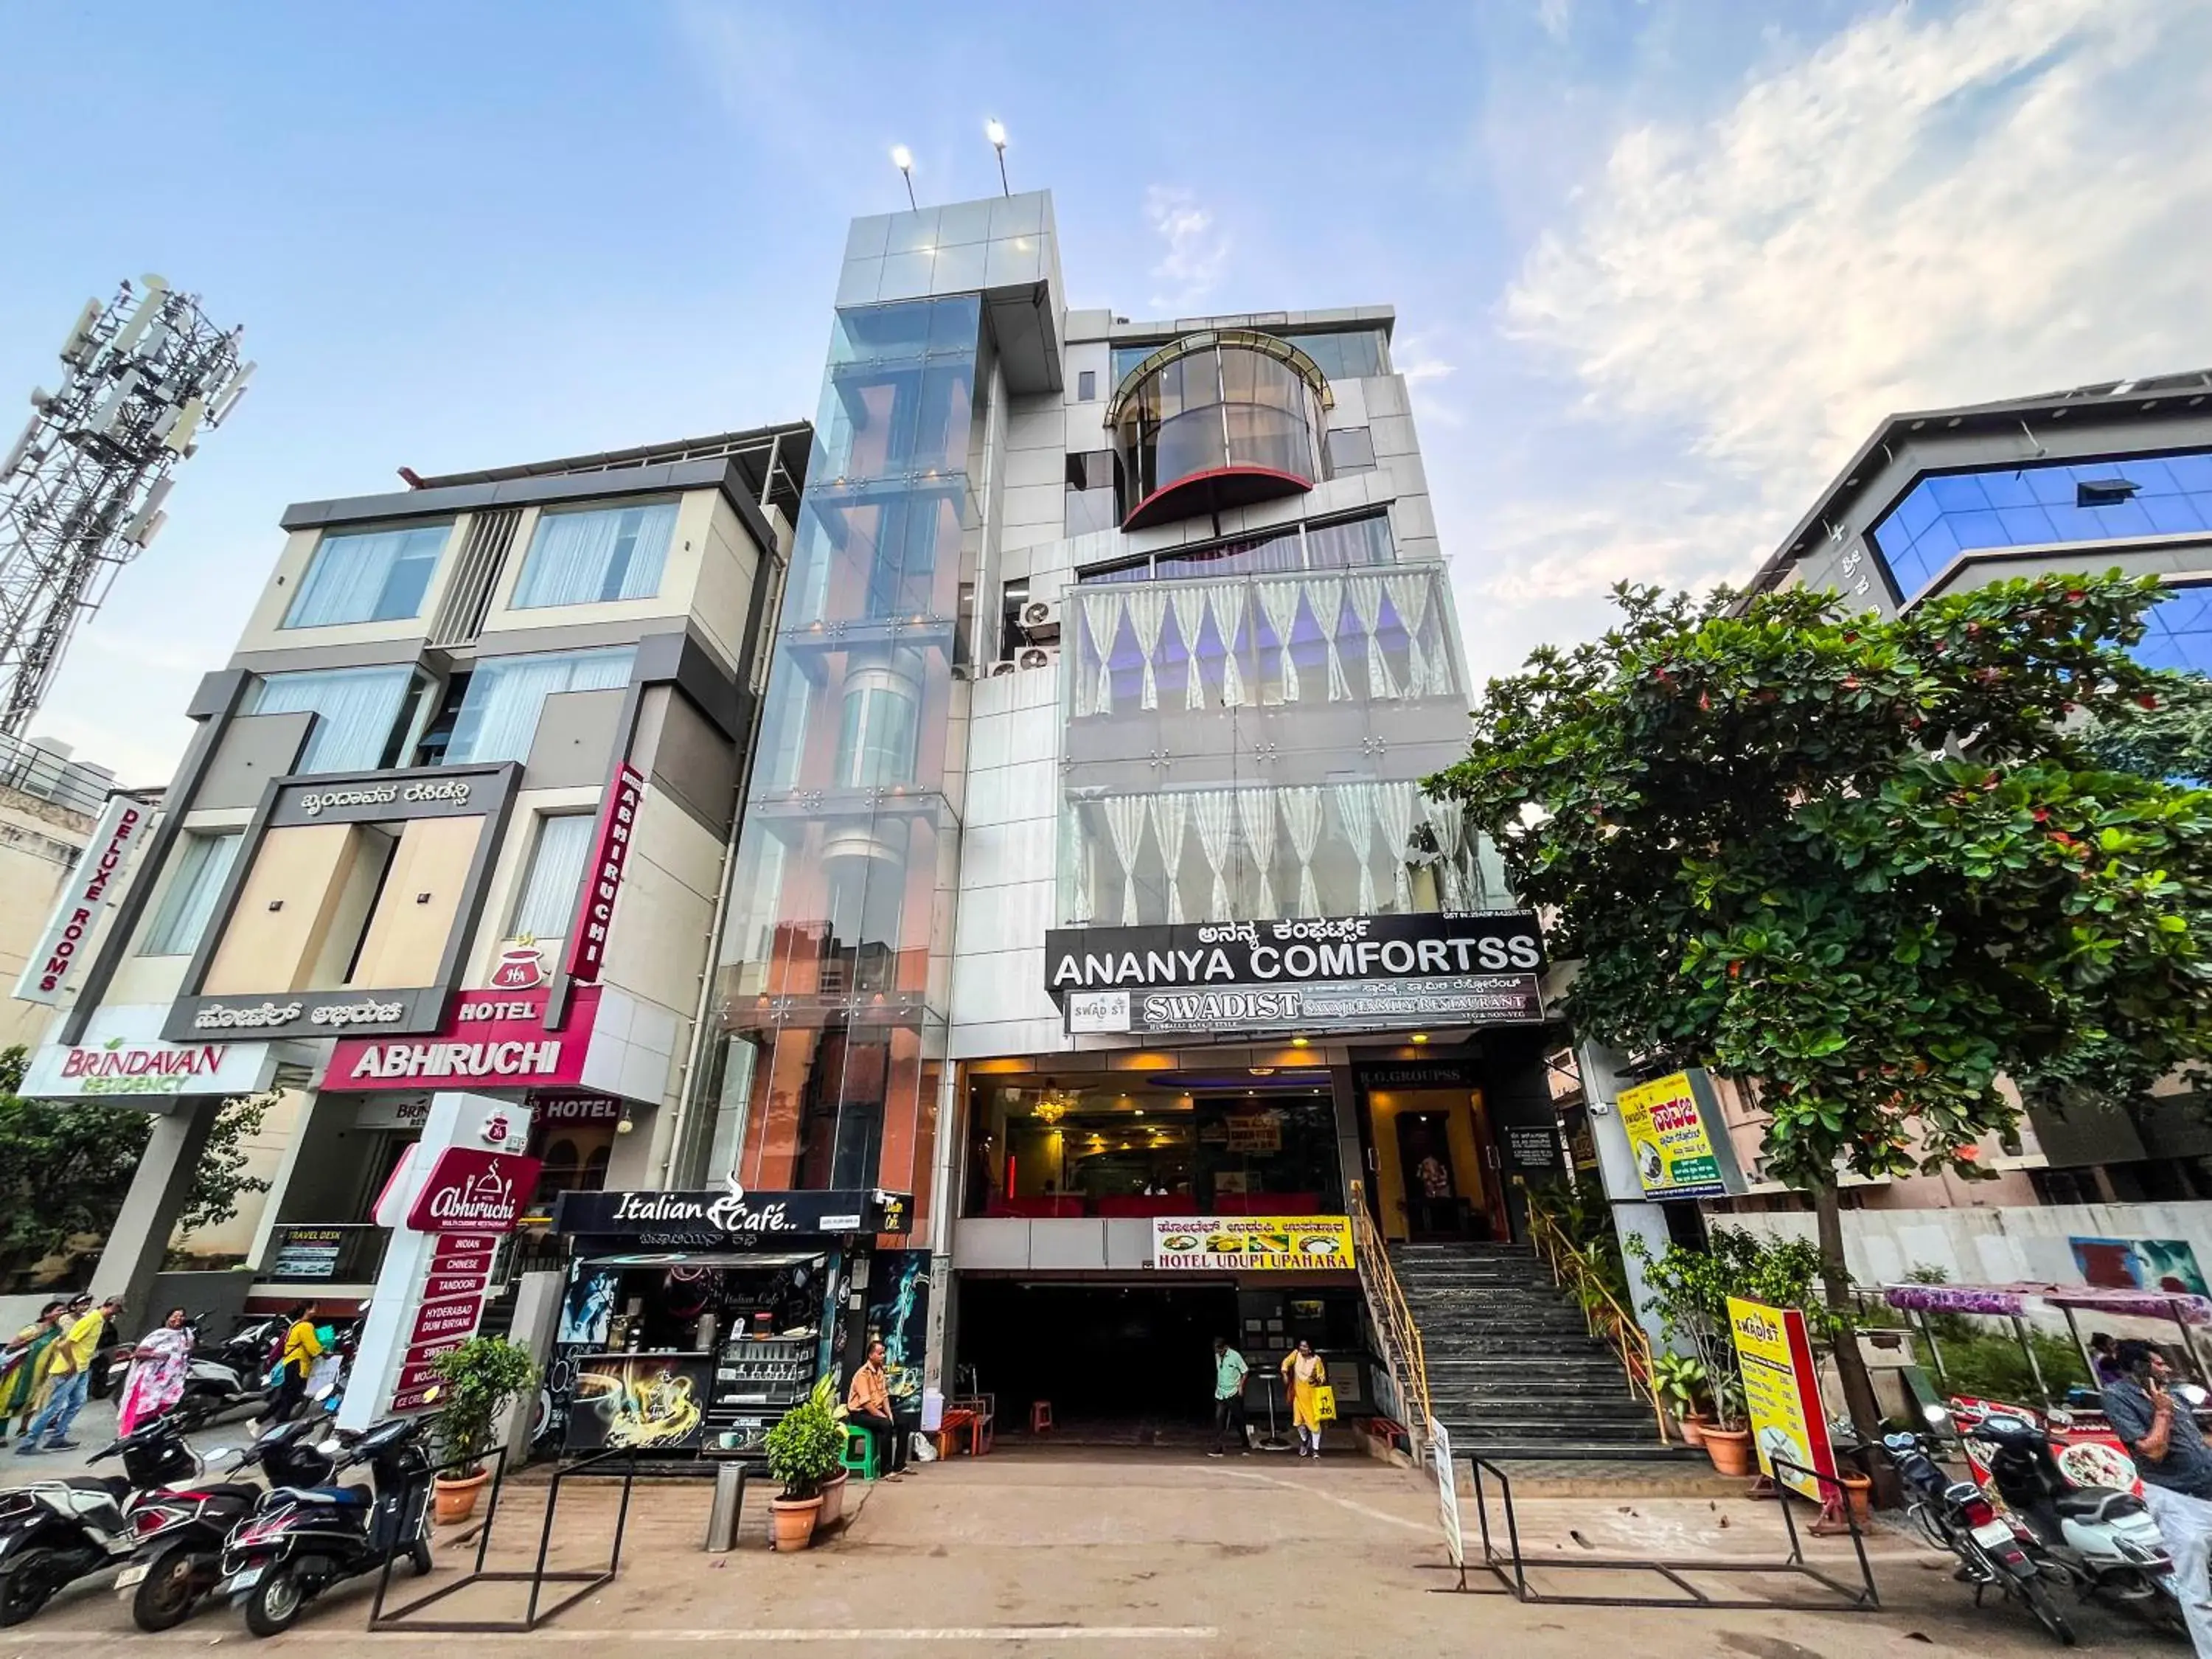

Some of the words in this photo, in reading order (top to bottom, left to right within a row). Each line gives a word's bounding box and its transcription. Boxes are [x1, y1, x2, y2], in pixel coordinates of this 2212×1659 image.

[301, 785, 397, 815] ಬೃಂದಾವನ
[83, 808, 139, 901] DELUXE
[587, 789, 635, 960] ABHIRUCHI
[1198, 921, 1259, 950] ಅನನ್ಯ
[39, 908, 90, 992] ROOMS
[1054, 948, 1235, 986] ANANYA
[1250, 936, 1540, 979] COMFORTSS
[459, 1001, 538, 1021] HOTEL
[1144, 992, 1302, 1022] SWADIST
[1419, 995, 1526, 1011] RESTAURANT
[61, 1045, 227, 1077] BRINDAVAN
[352, 1040, 561, 1078] ABHIRUCHI
[547, 1100, 616, 1117] HOTEL
[613, 1192, 703, 1220] Italian
[288, 1231, 318, 1239] TRAVEL
[319, 1231, 341, 1239] DESK
[455, 1239, 480, 1248] INDIAN
[447, 1259, 479, 1269] CHINESE
[1159, 1254, 1211, 1267] HOTEL
[1217, 1254, 1265, 1267] UDUPI
[1271, 1254, 1348, 1267] UPAHARA
[439, 1279, 477, 1291] TANDOORI
[425, 1305, 473, 1318] HYDERABAD
[441, 1317, 471, 1329] BIRYANI
